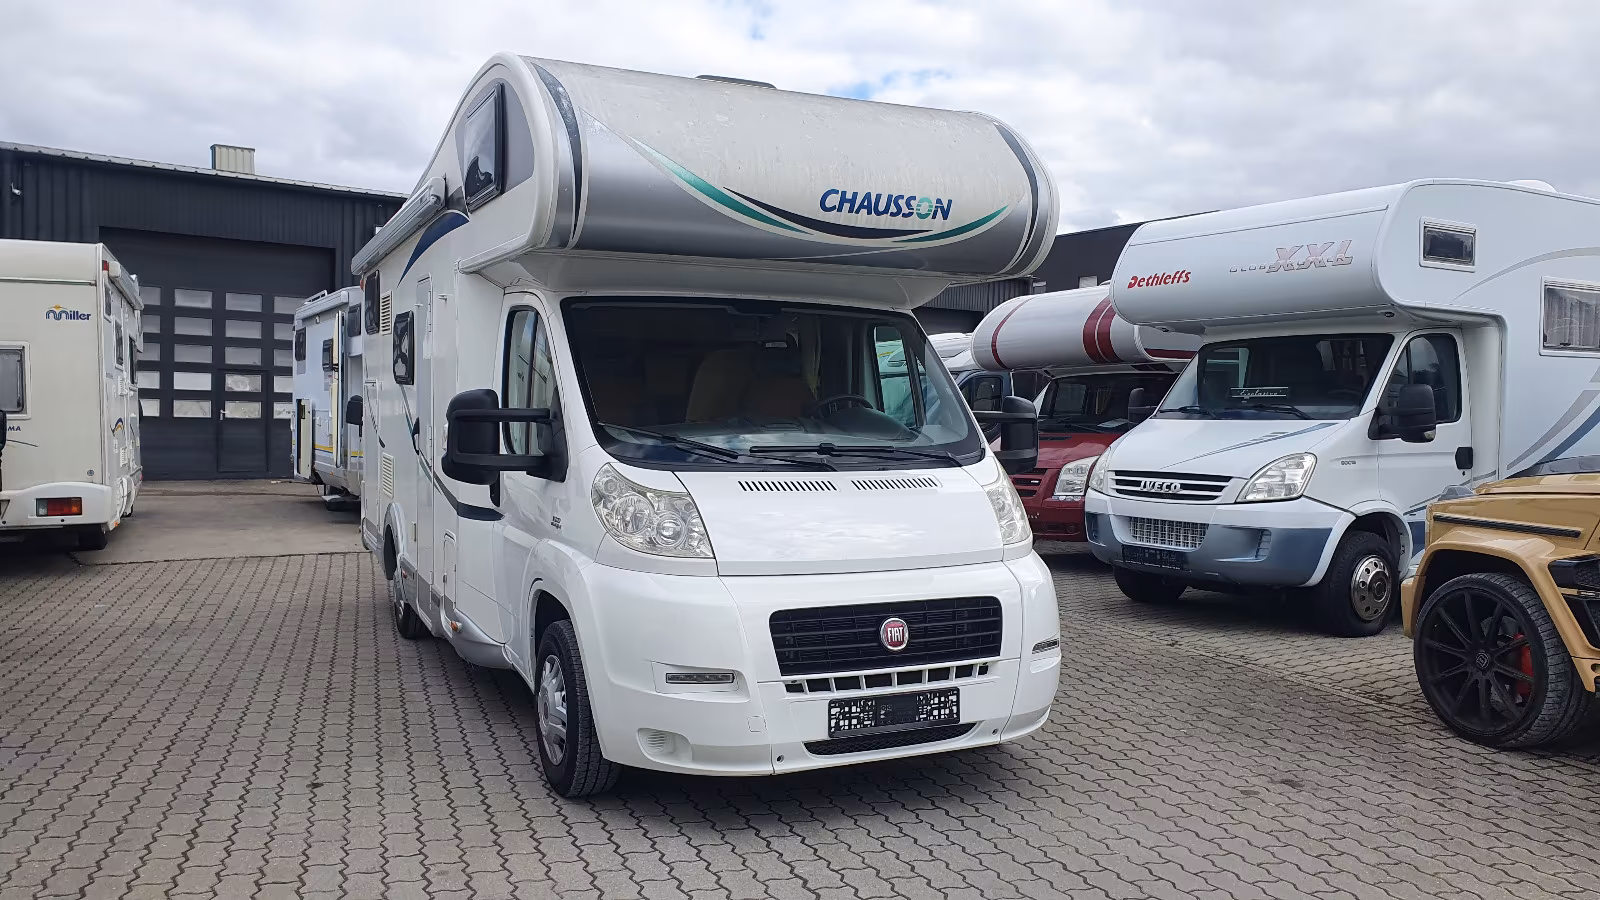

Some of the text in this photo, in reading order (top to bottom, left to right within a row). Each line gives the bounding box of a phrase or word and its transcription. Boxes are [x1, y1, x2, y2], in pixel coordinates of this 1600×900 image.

[818, 188, 953, 221] CHAUSSON
[1265, 239, 1354, 273] XXL
[1128, 269, 1193, 289] Dethleffs
[1140, 480, 1182, 493] IVECO
[888, 627, 903, 642] FIAT
